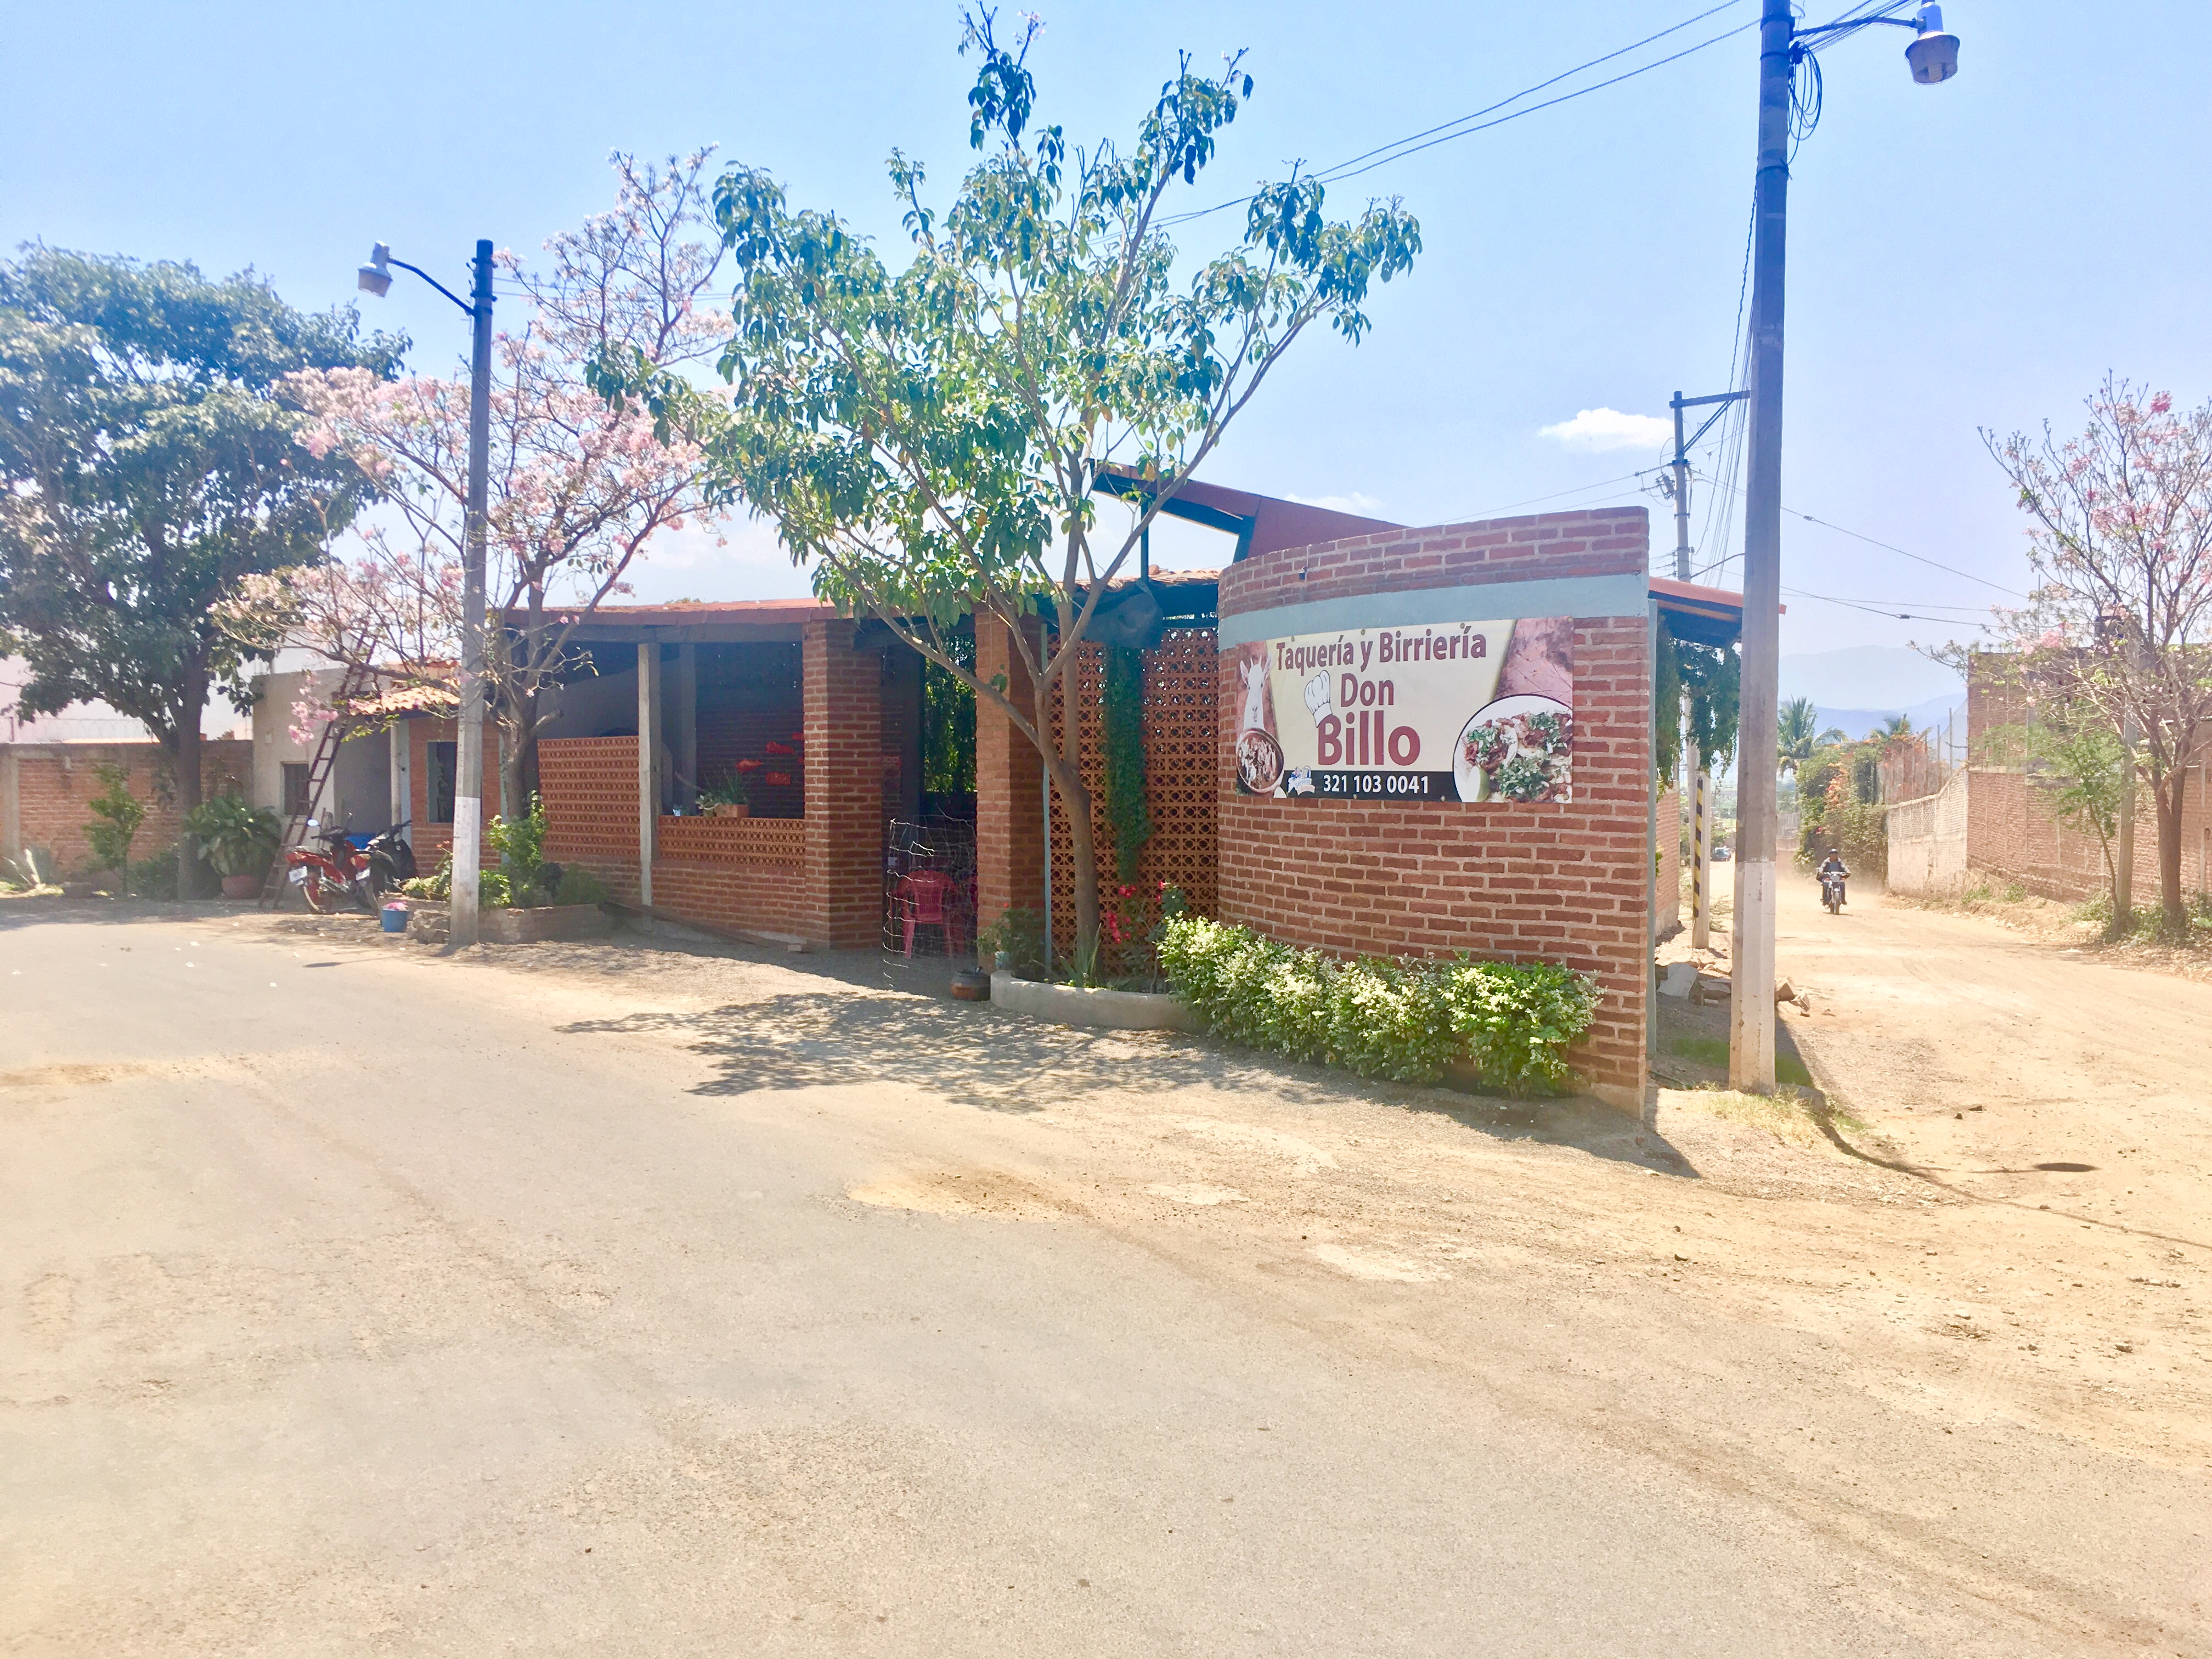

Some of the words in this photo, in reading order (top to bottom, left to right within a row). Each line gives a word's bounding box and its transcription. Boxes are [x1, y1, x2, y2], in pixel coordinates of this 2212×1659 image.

[1276, 635, 1354, 676] Taquería
[1360, 641, 1373, 673] y
[1379, 625, 1486, 663] Birriería
[1340, 673, 1394, 707] Don
[1318, 710, 1421, 766] Billo
[1323, 774, 1347, 792] 321
[1353, 775, 1381, 793] 103
[1386, 775, 1429, 794] 0041
